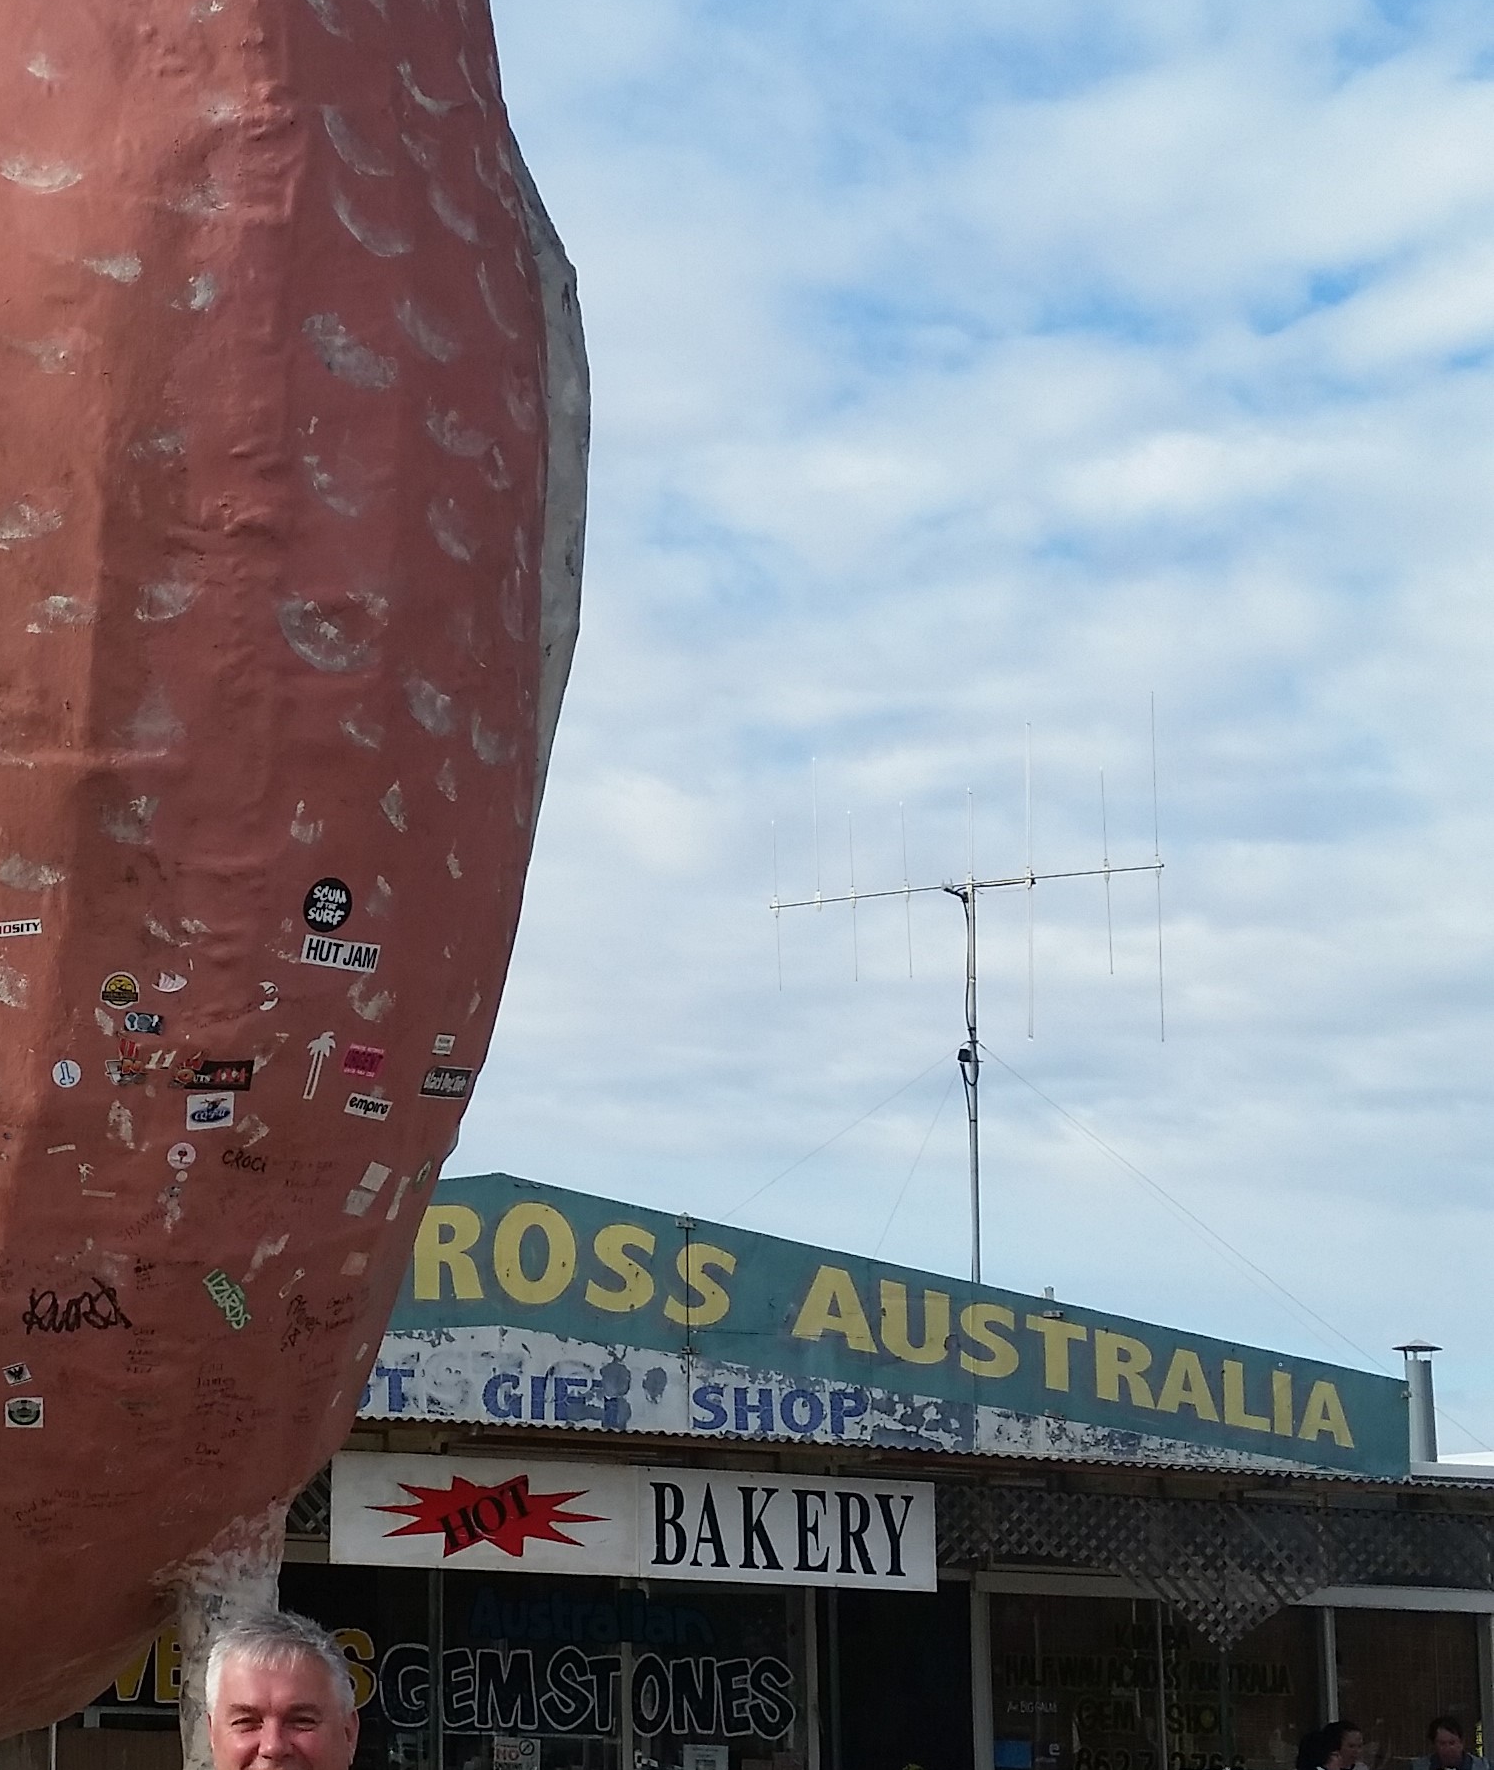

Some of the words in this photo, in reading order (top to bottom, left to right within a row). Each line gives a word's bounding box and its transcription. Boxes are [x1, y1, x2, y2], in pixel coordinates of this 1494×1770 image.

[312, 885, 347, 904] SCUM
[307, 907, 345, 926] SURF
[305, 937, 344, 964] HUT
[342, 944, 379, 970] JAM
[348, 1096, 389, 1115] empire
[790, 1264, 1355, 1449] AUSTRALIA
[691, 1384, 869, 1435] SHOP
[437, 1478, 534, 1548] HOT
[649, 1480, 915, 1577] BAKERY
[469, 1586, 716, 1645] Australian
[378, 1641, 797, 1741] GEMSTONES
[1073, 1695, 1137, 1735] GEM
[495, 1748, 520, 1761] NO
